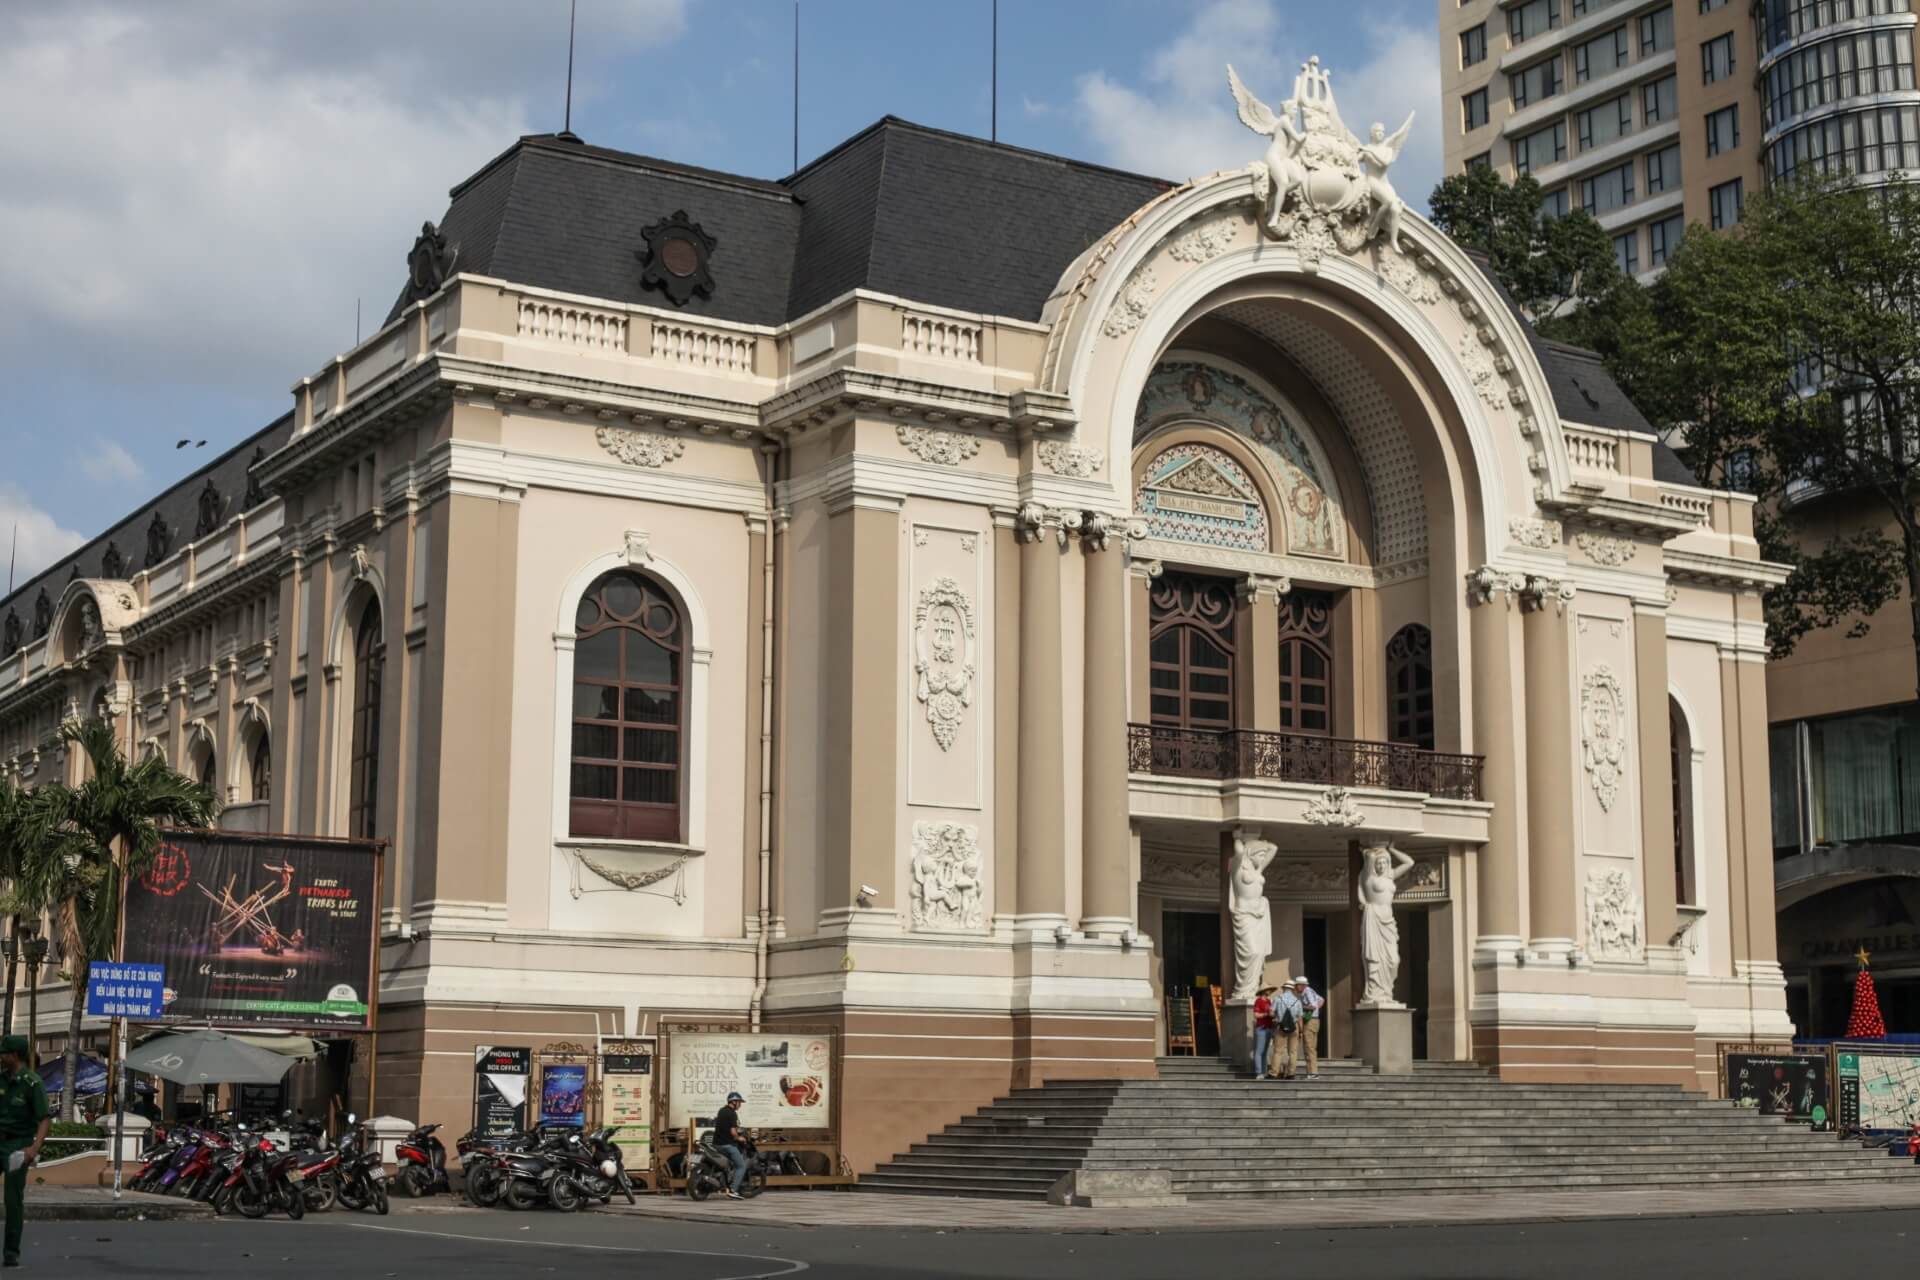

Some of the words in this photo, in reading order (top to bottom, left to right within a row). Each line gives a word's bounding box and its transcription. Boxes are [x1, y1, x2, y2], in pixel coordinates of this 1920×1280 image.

[307, 898, 336, 909] TRIBES
[682, 1051, 738, 1064] SAIGON
[682, 1065, 738, 1079] OPERA
[681, 1080, 738, 1095] HOUSE
